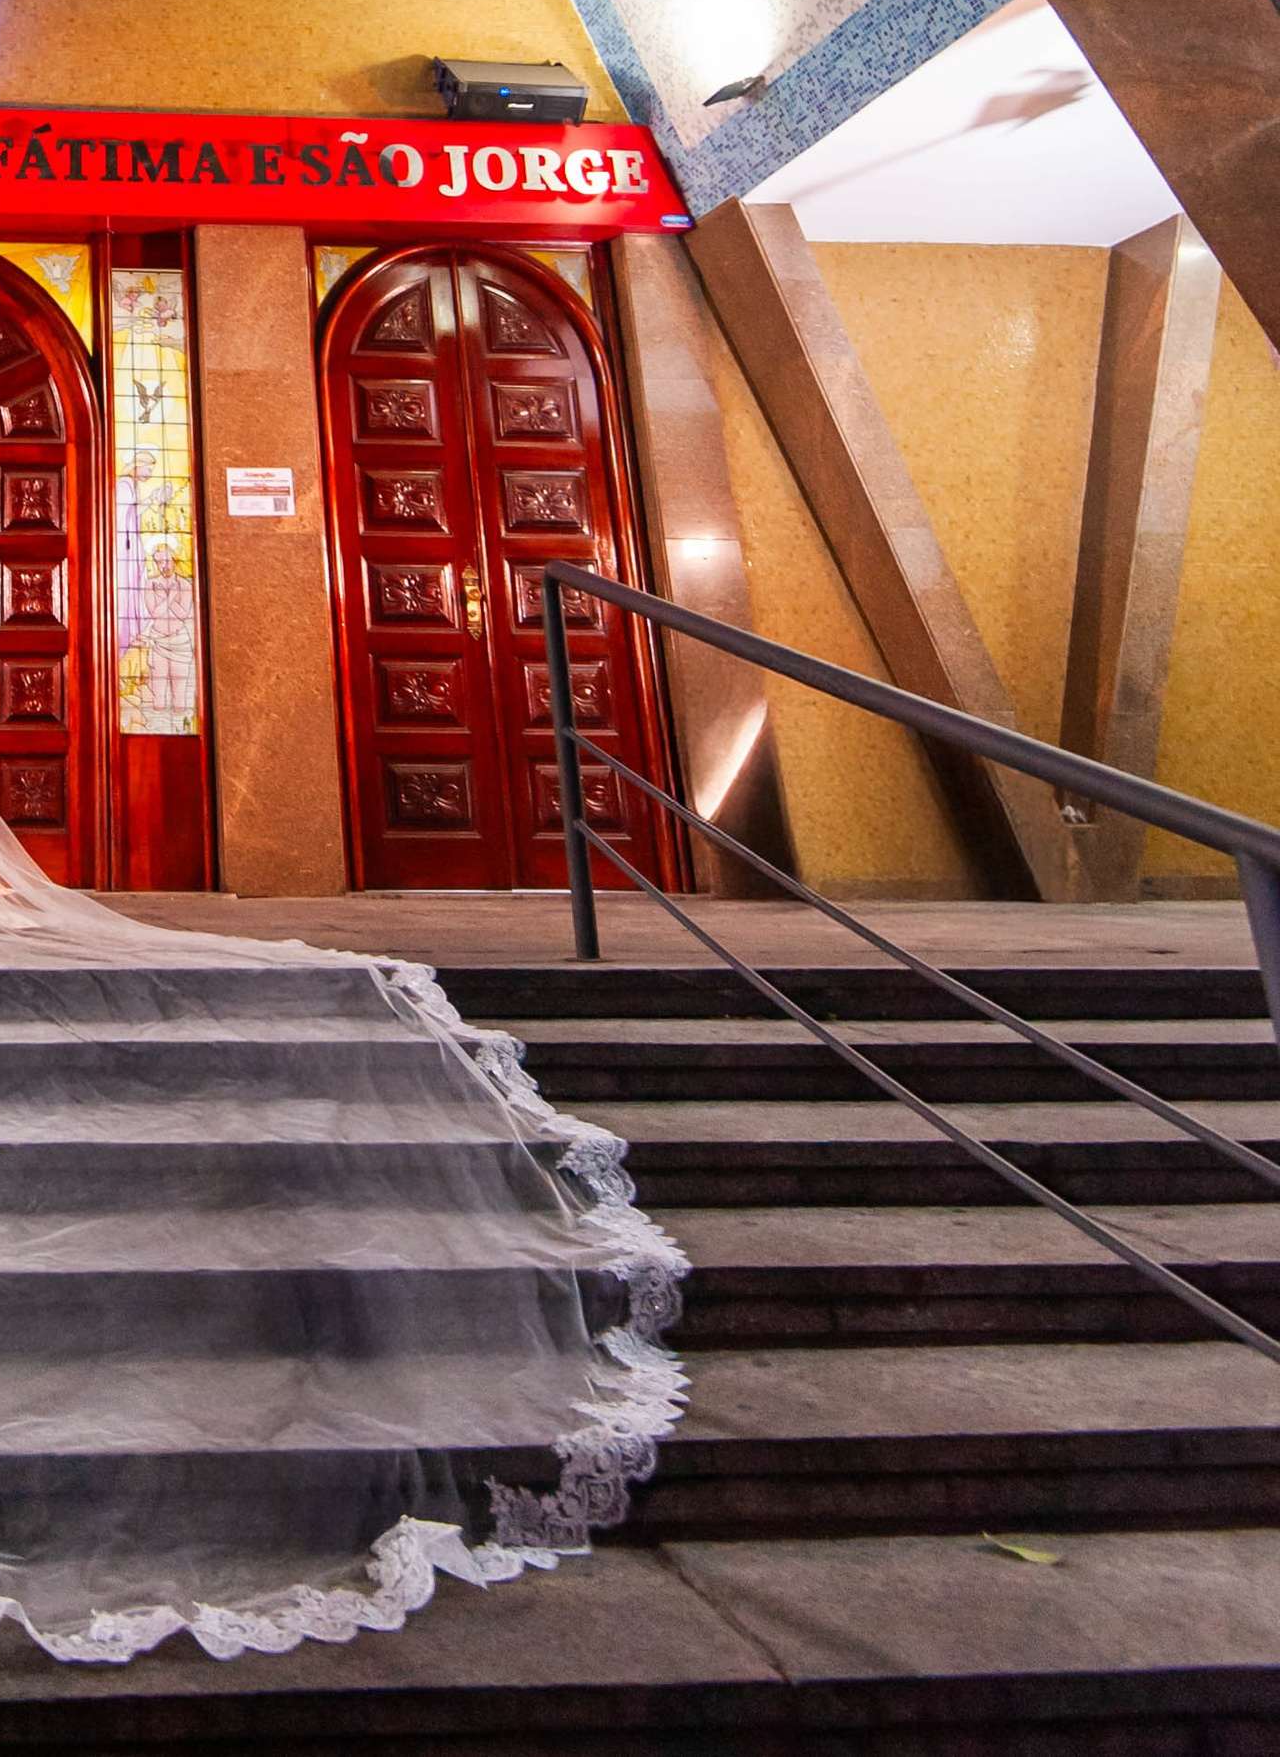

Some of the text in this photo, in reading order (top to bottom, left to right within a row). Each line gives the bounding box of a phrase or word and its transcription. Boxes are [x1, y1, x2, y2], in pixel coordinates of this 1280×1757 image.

[248, 143, 285, 185] E
[299, 131, 423, 188] SÃO
[438, 145, 649, 197] JORGE
